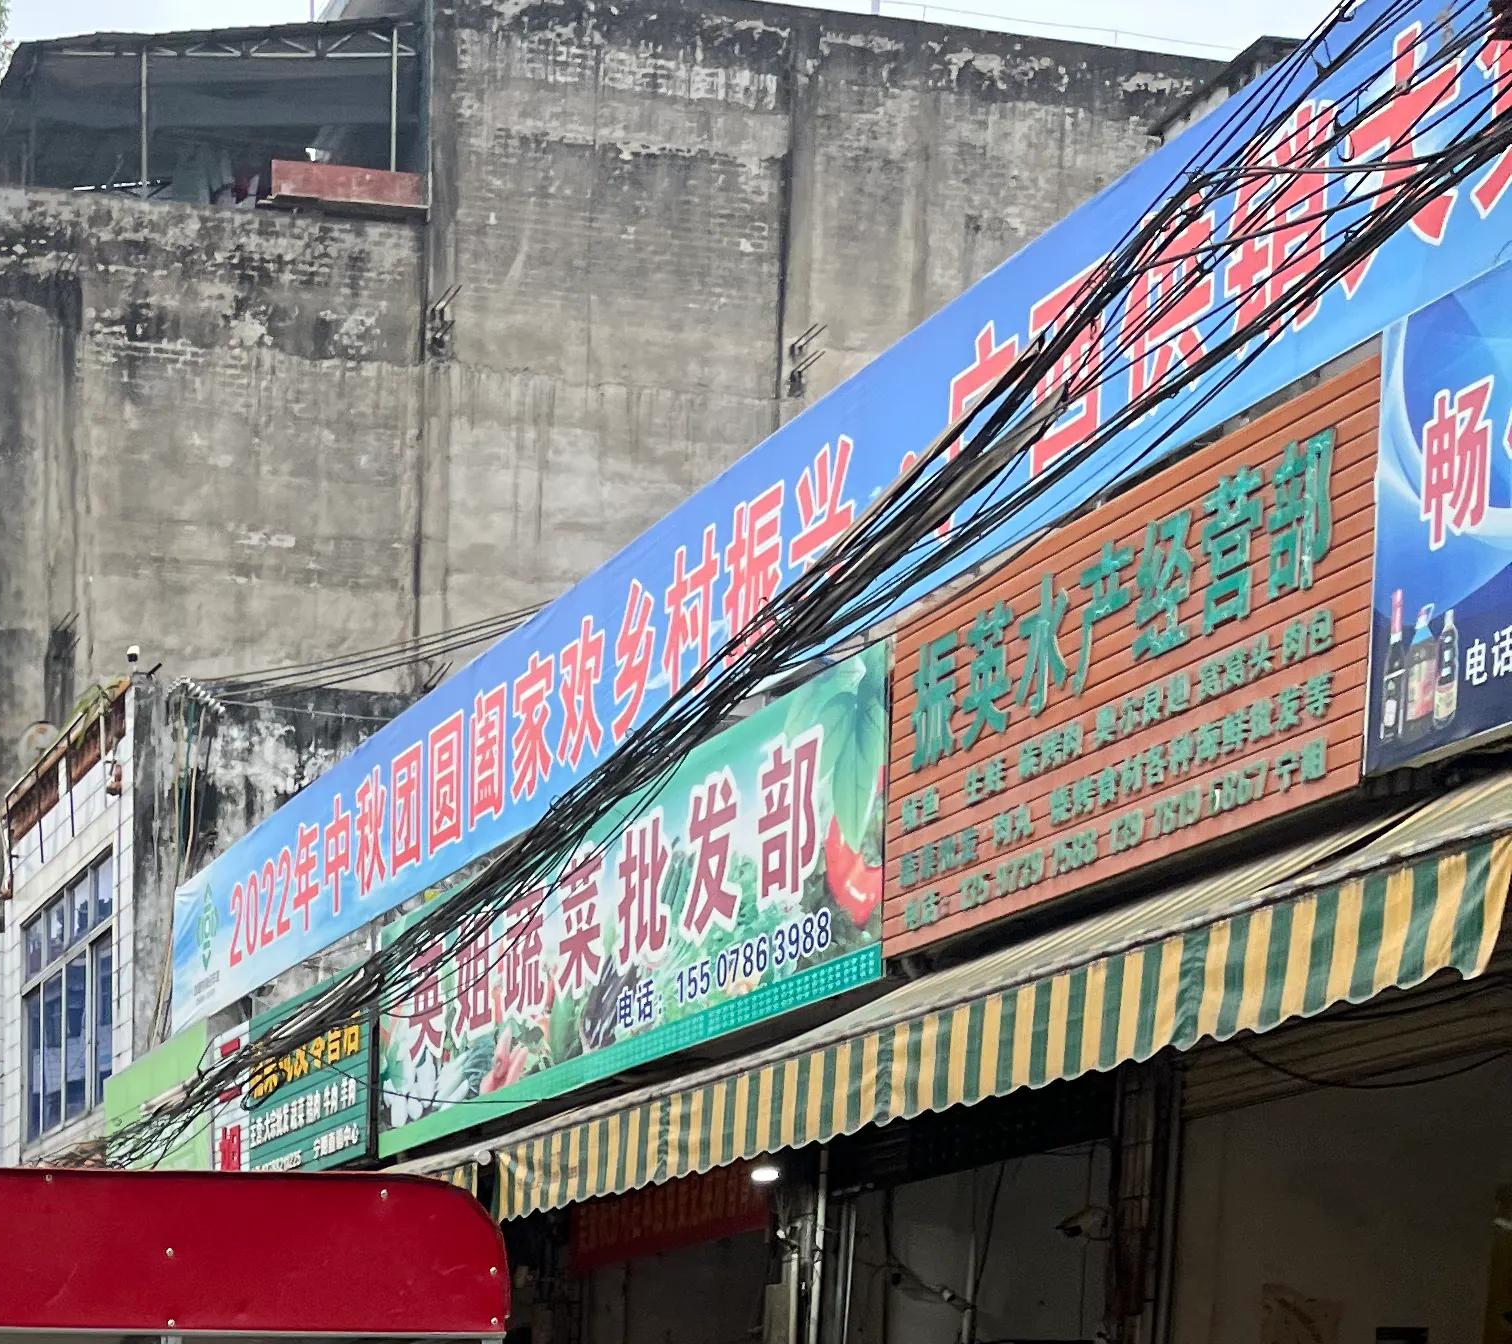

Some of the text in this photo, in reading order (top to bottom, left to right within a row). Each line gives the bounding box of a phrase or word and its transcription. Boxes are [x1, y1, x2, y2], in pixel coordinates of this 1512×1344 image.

[1423, 377, 1512, 550] 畅
[911, 428, 1337, 772] 振英水产经营部
[676, 964, 710, 1004] 155
[716, 942, 770, 989] 0786
[774, 909, 831, 966] 3988
